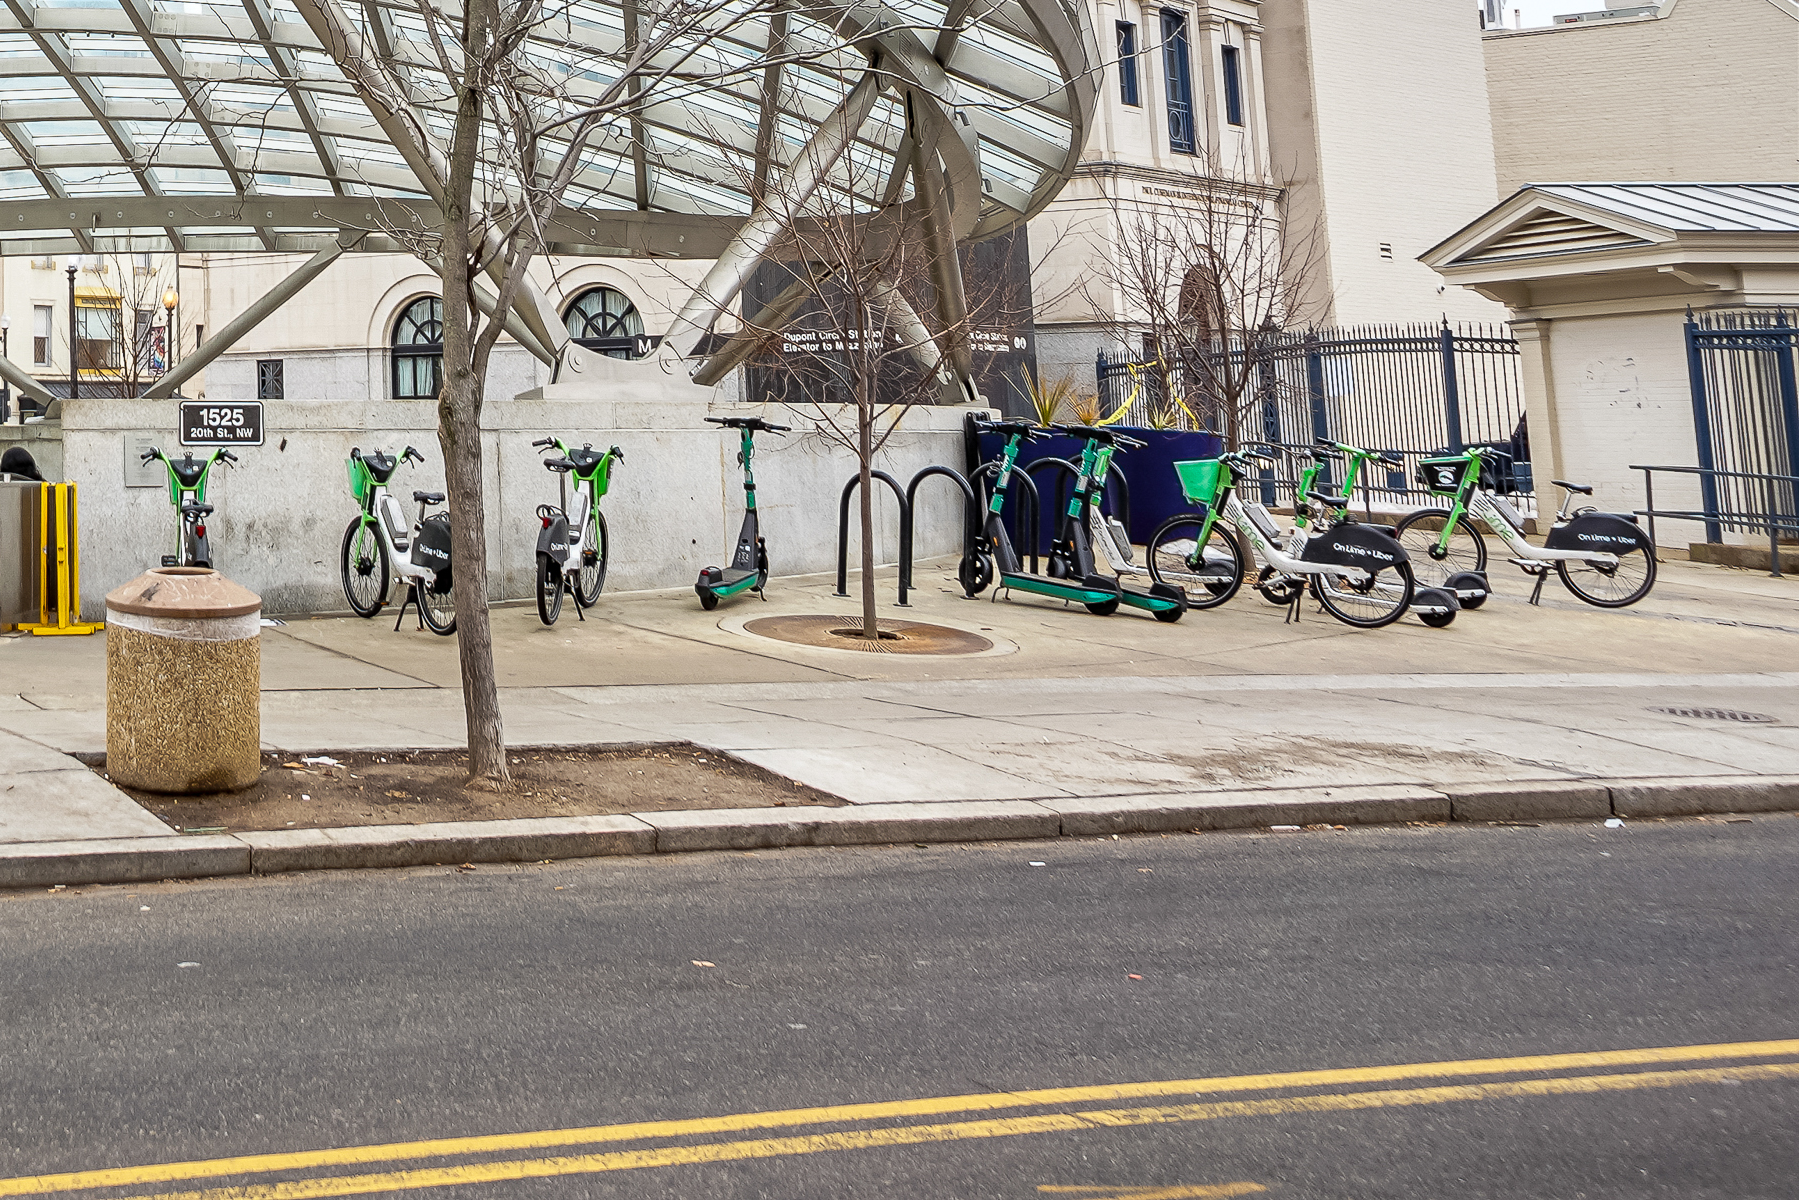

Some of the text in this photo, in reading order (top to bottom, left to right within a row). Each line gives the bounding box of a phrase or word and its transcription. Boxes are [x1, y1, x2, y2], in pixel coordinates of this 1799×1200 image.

[783, 331, 816, 342] Dupont
[822, 342, 833, 351] to
[199, 408, 244, 426] 1525
[190, 428, 213, 438] 20th
[236, 428, 253, 438] NW
[1577, 533, 1591, 541] On
[1591, 533, 1611, 542] Lime
[1617, 536, 1637, 545] Uber
[1332, 542, 1345, 551] On
[1345, 544, 1366, 555] Lime
[1372, 550, 1394, 561] Uber
